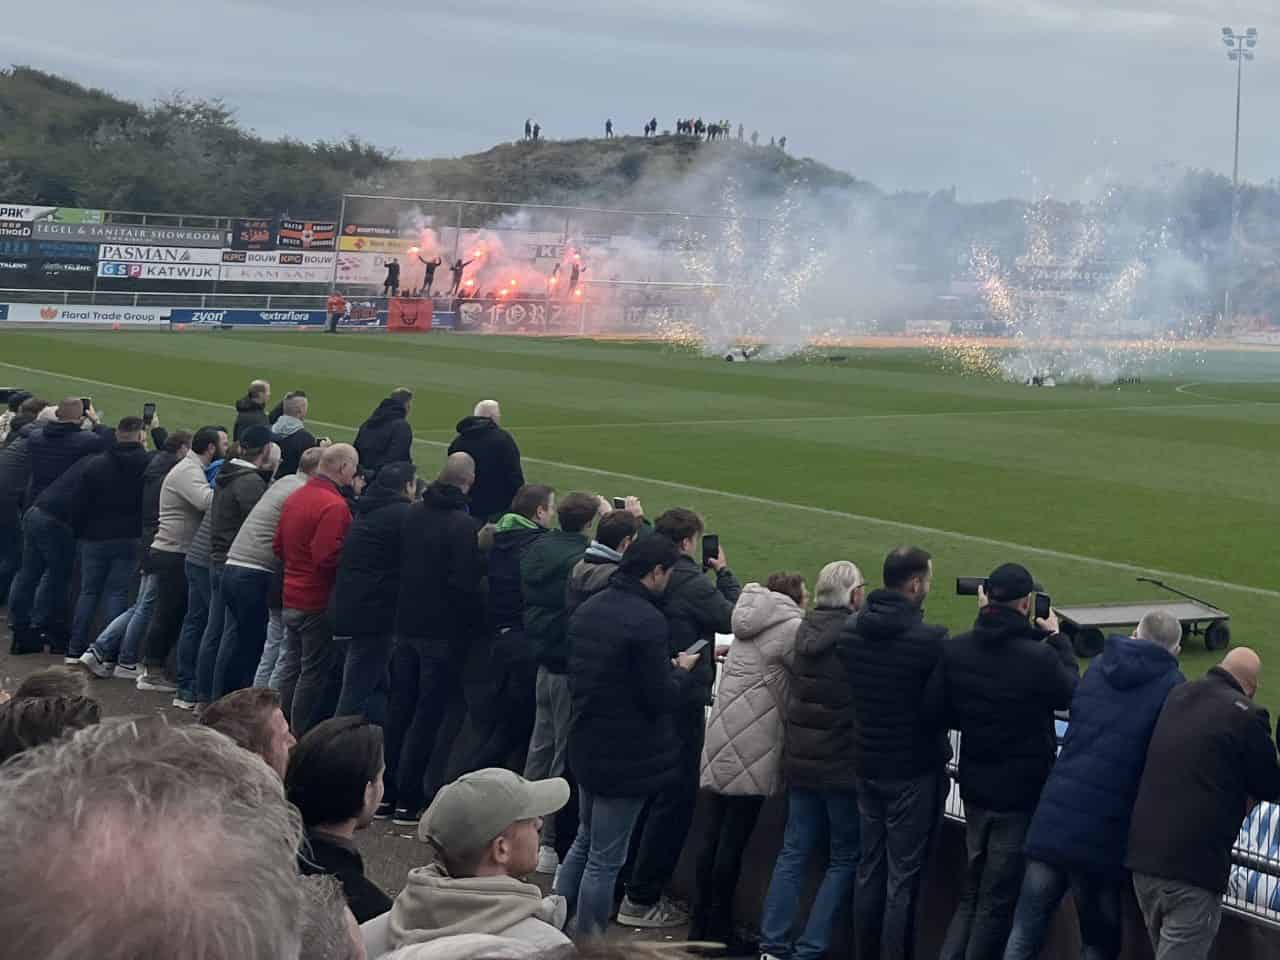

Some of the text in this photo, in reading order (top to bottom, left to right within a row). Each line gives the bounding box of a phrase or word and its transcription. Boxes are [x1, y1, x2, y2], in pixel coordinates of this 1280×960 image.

[37, 224, 72, 234] TEGEL
[91, 227, 146, 238] SANITAIR
[152, 230, 220, 241] SHOWROOM
[103, 246, 178, 261] PASMAN
[248, 255, 277, 263] BOUW
[305, 256, 333, 264] BOUW
[103, 264, 213, 277] GSP KATWIJK
[61, 311, 155, 322] Floral Trade Group
